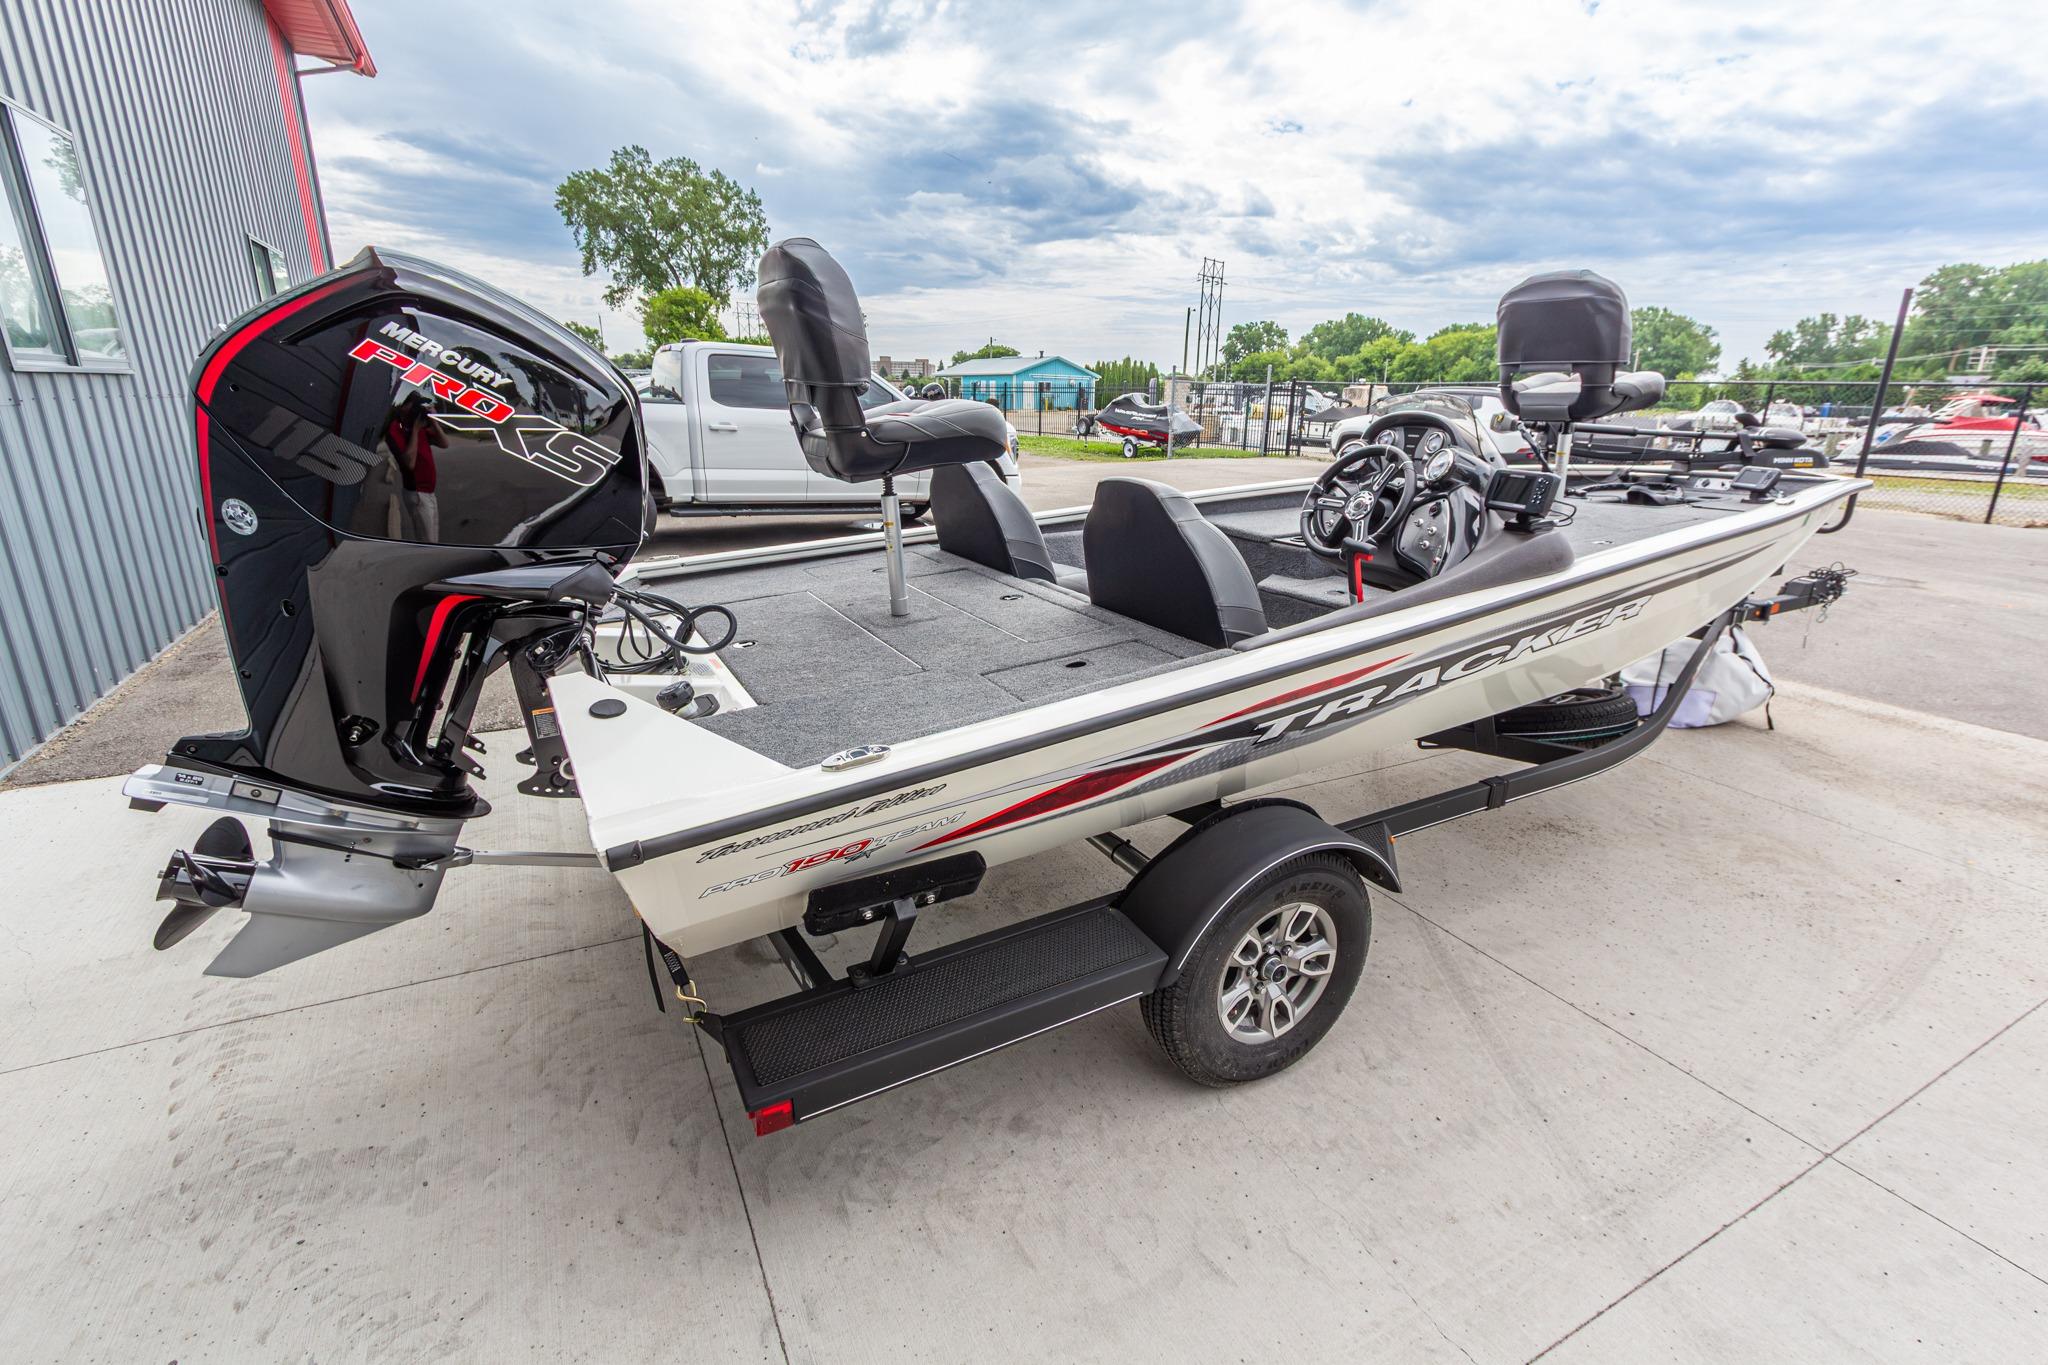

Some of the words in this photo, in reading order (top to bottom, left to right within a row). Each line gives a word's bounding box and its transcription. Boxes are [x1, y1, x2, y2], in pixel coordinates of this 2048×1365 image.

[348, 337, 515, 424] PRO
[379, 321, 513, 388] MERCURY
[427, 384, 623, 486] XS
[1252, 594, 1655, 746] TRACKER
[698, 867, 783, 899] PRO
[874, 811, 966, 846] TEAM
